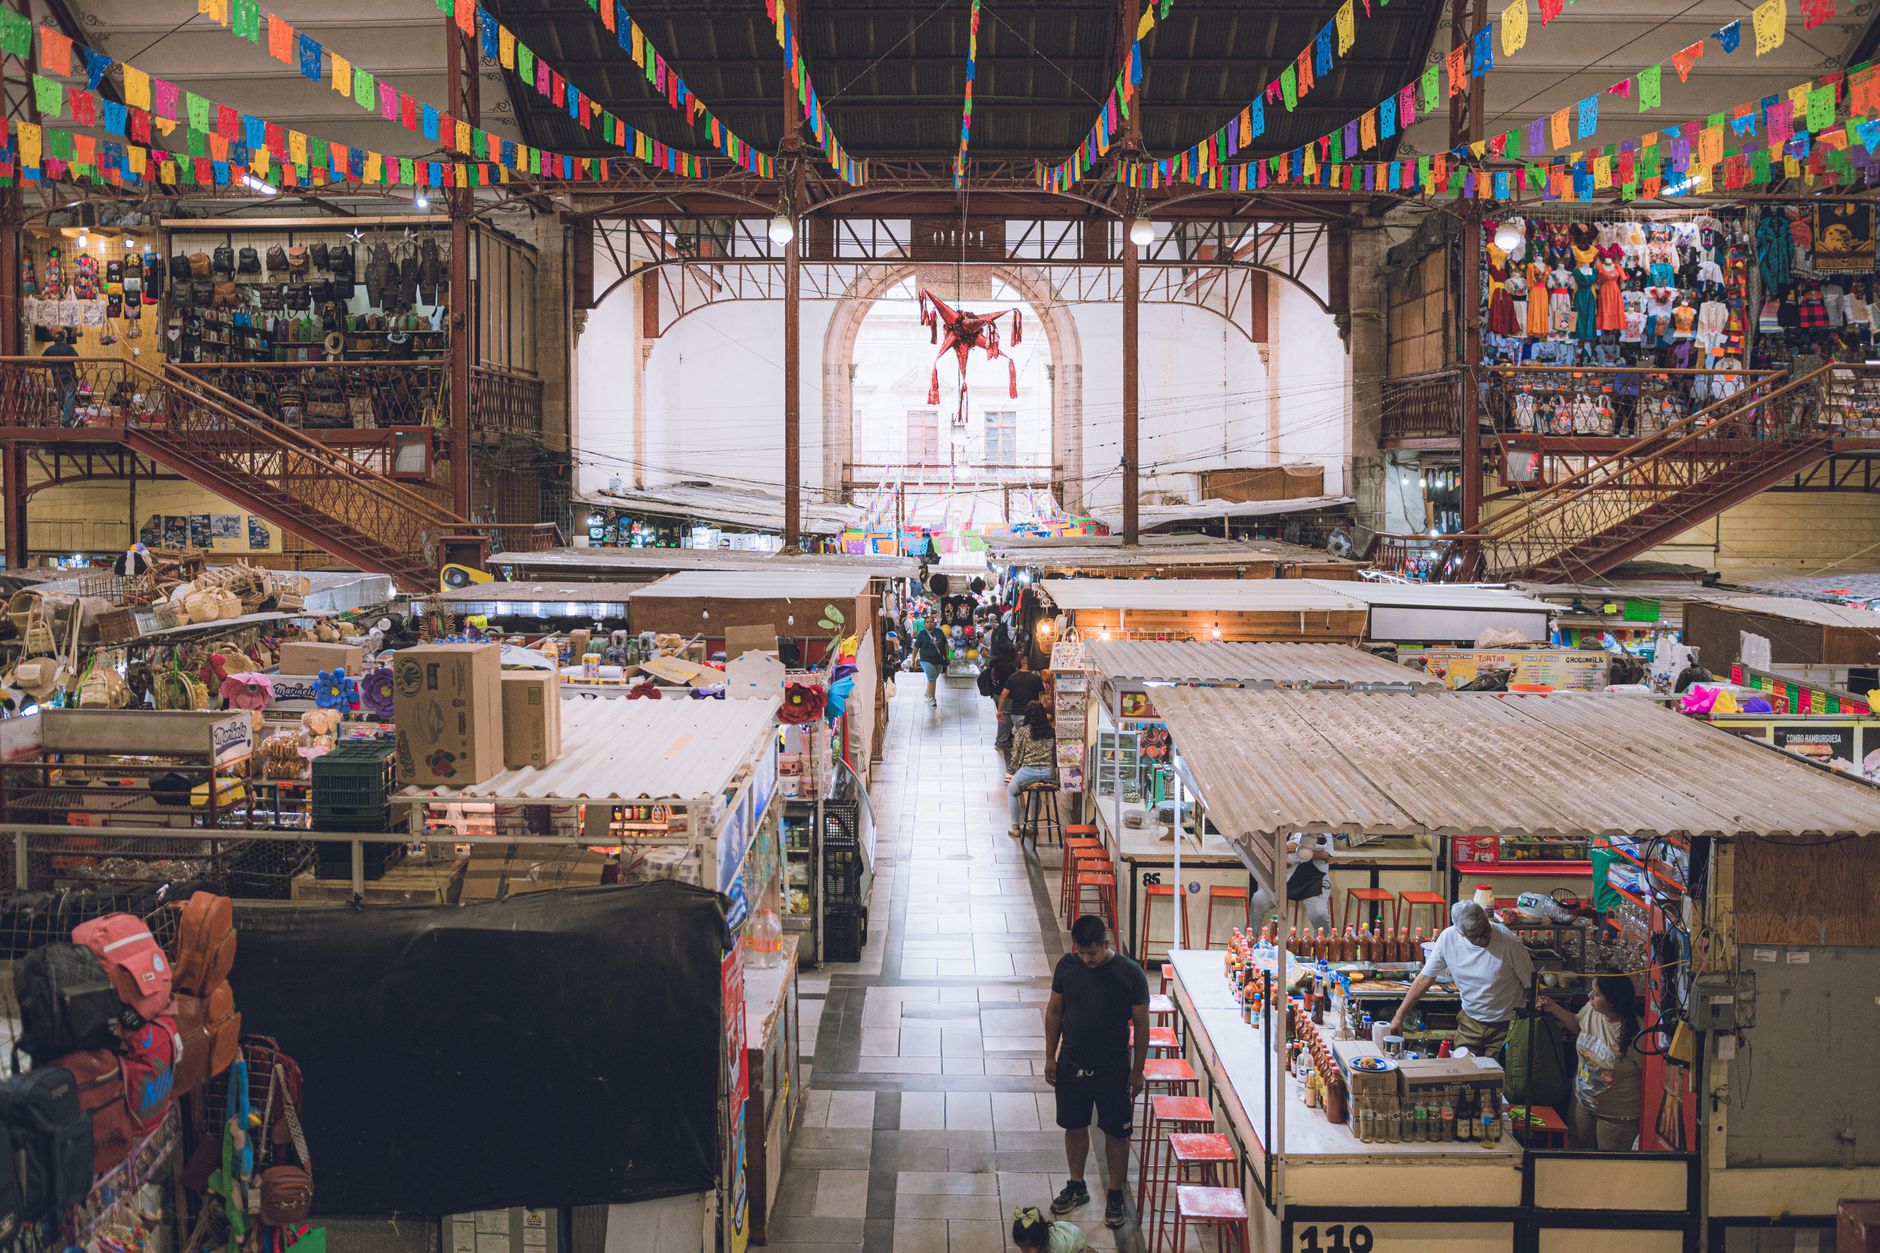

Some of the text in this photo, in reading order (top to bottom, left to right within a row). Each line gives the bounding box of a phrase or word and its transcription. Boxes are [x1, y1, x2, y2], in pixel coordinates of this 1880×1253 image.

[273, 682, 317, 698] Marinela
[213, 721, 248, 746] Marinela
[1786, 734, 1842, 743] COMBO HAMBURGUESA
[1142, 872, 1161, 887] 85
[1299, 1224, 1374, 1253] 110
